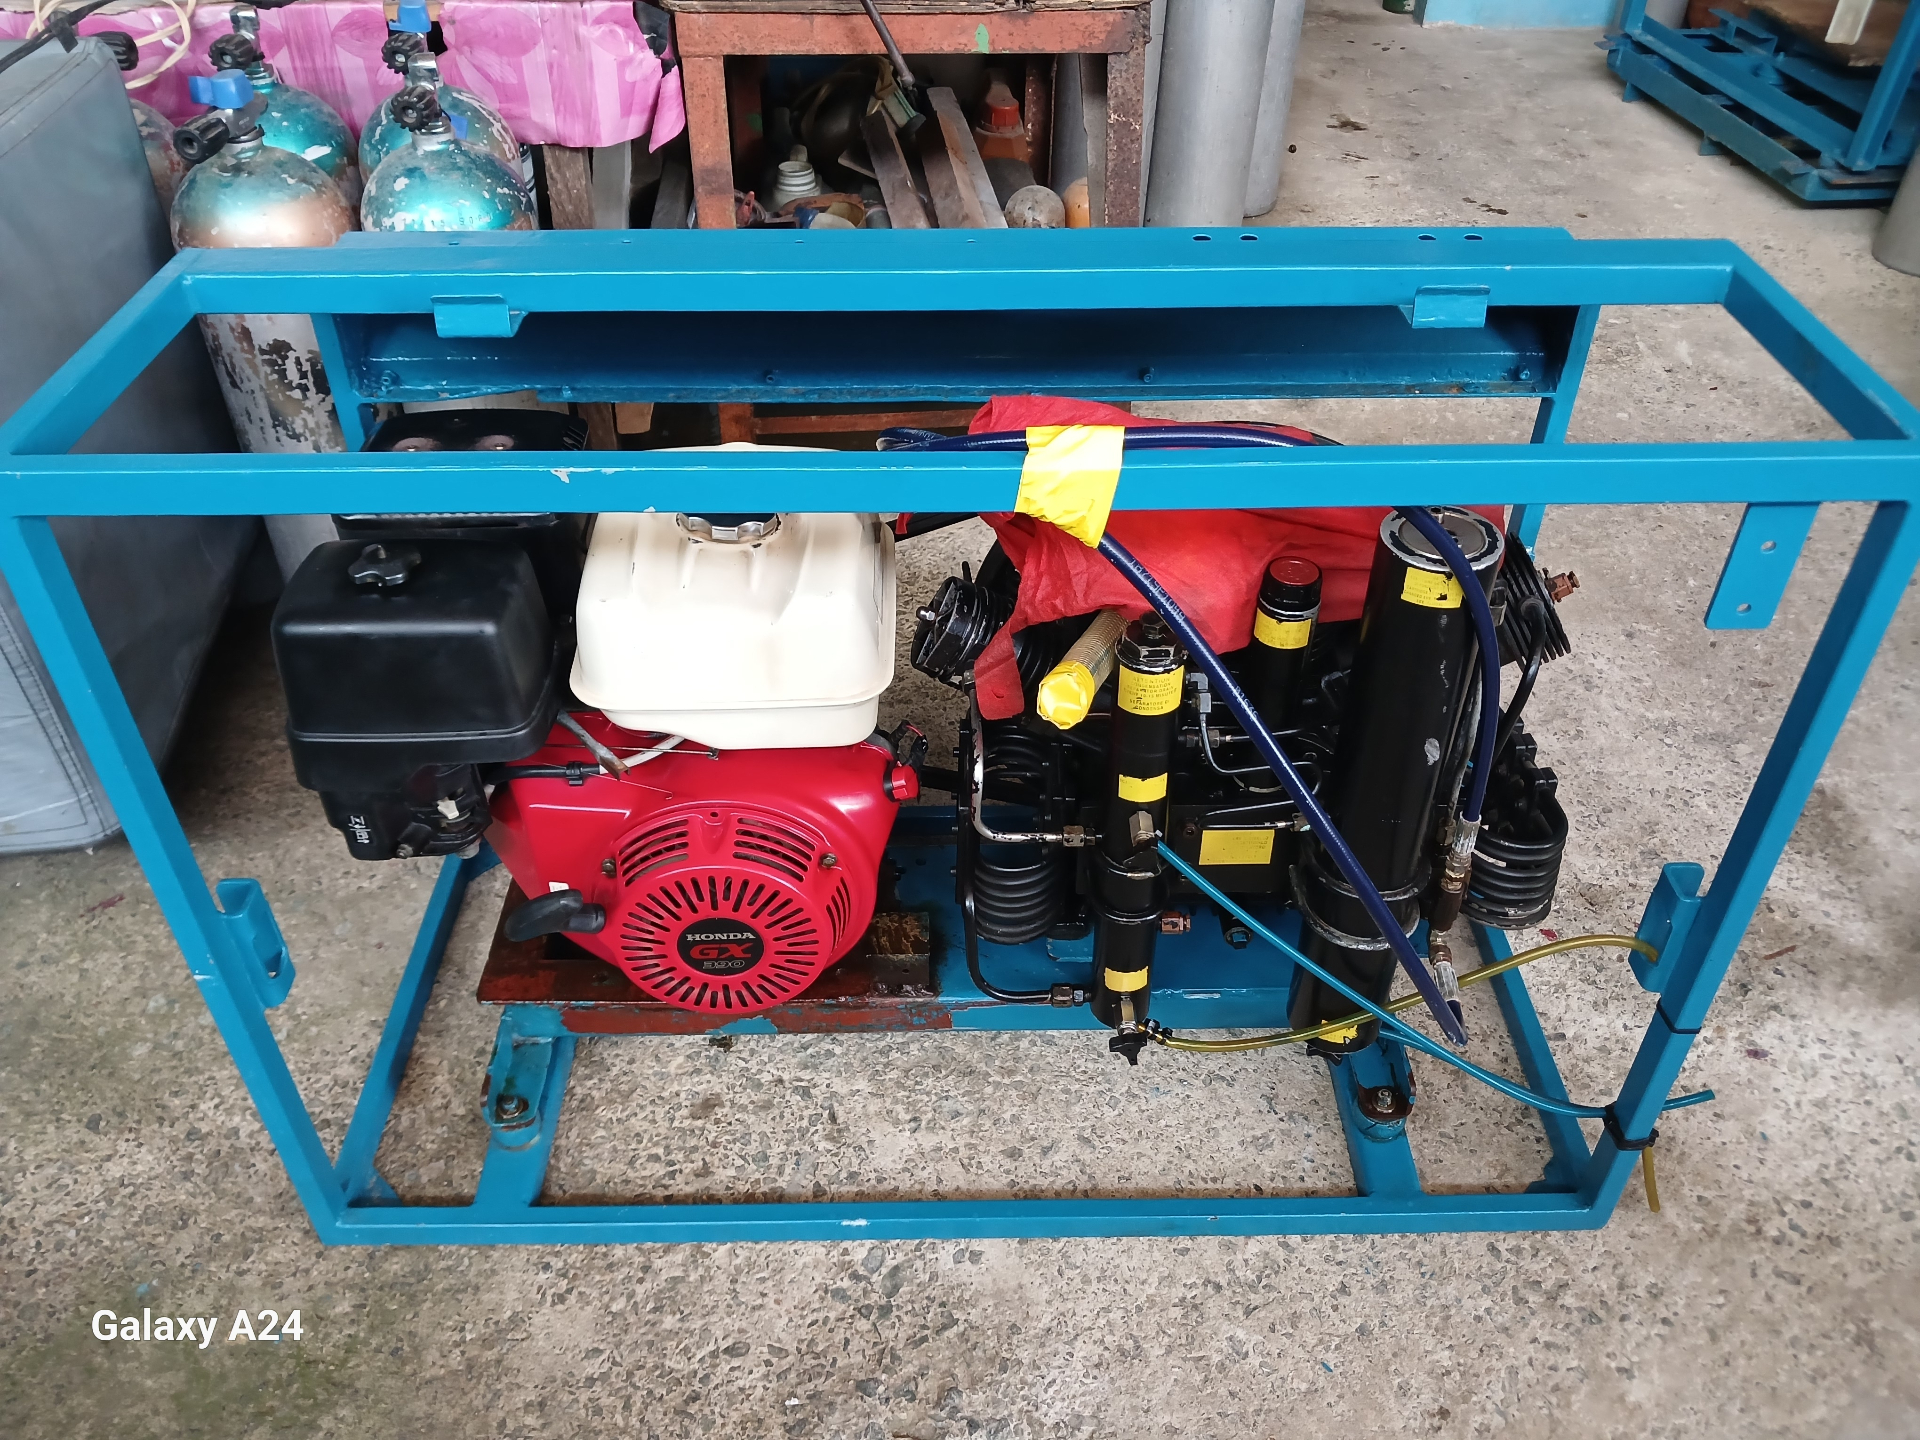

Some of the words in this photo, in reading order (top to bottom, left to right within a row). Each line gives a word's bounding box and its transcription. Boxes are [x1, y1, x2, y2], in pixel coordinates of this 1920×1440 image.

[686, 932, 756, 940] HONDA
[690, 943, 753, 958] GX
[703, 960, 745, 969] 390
